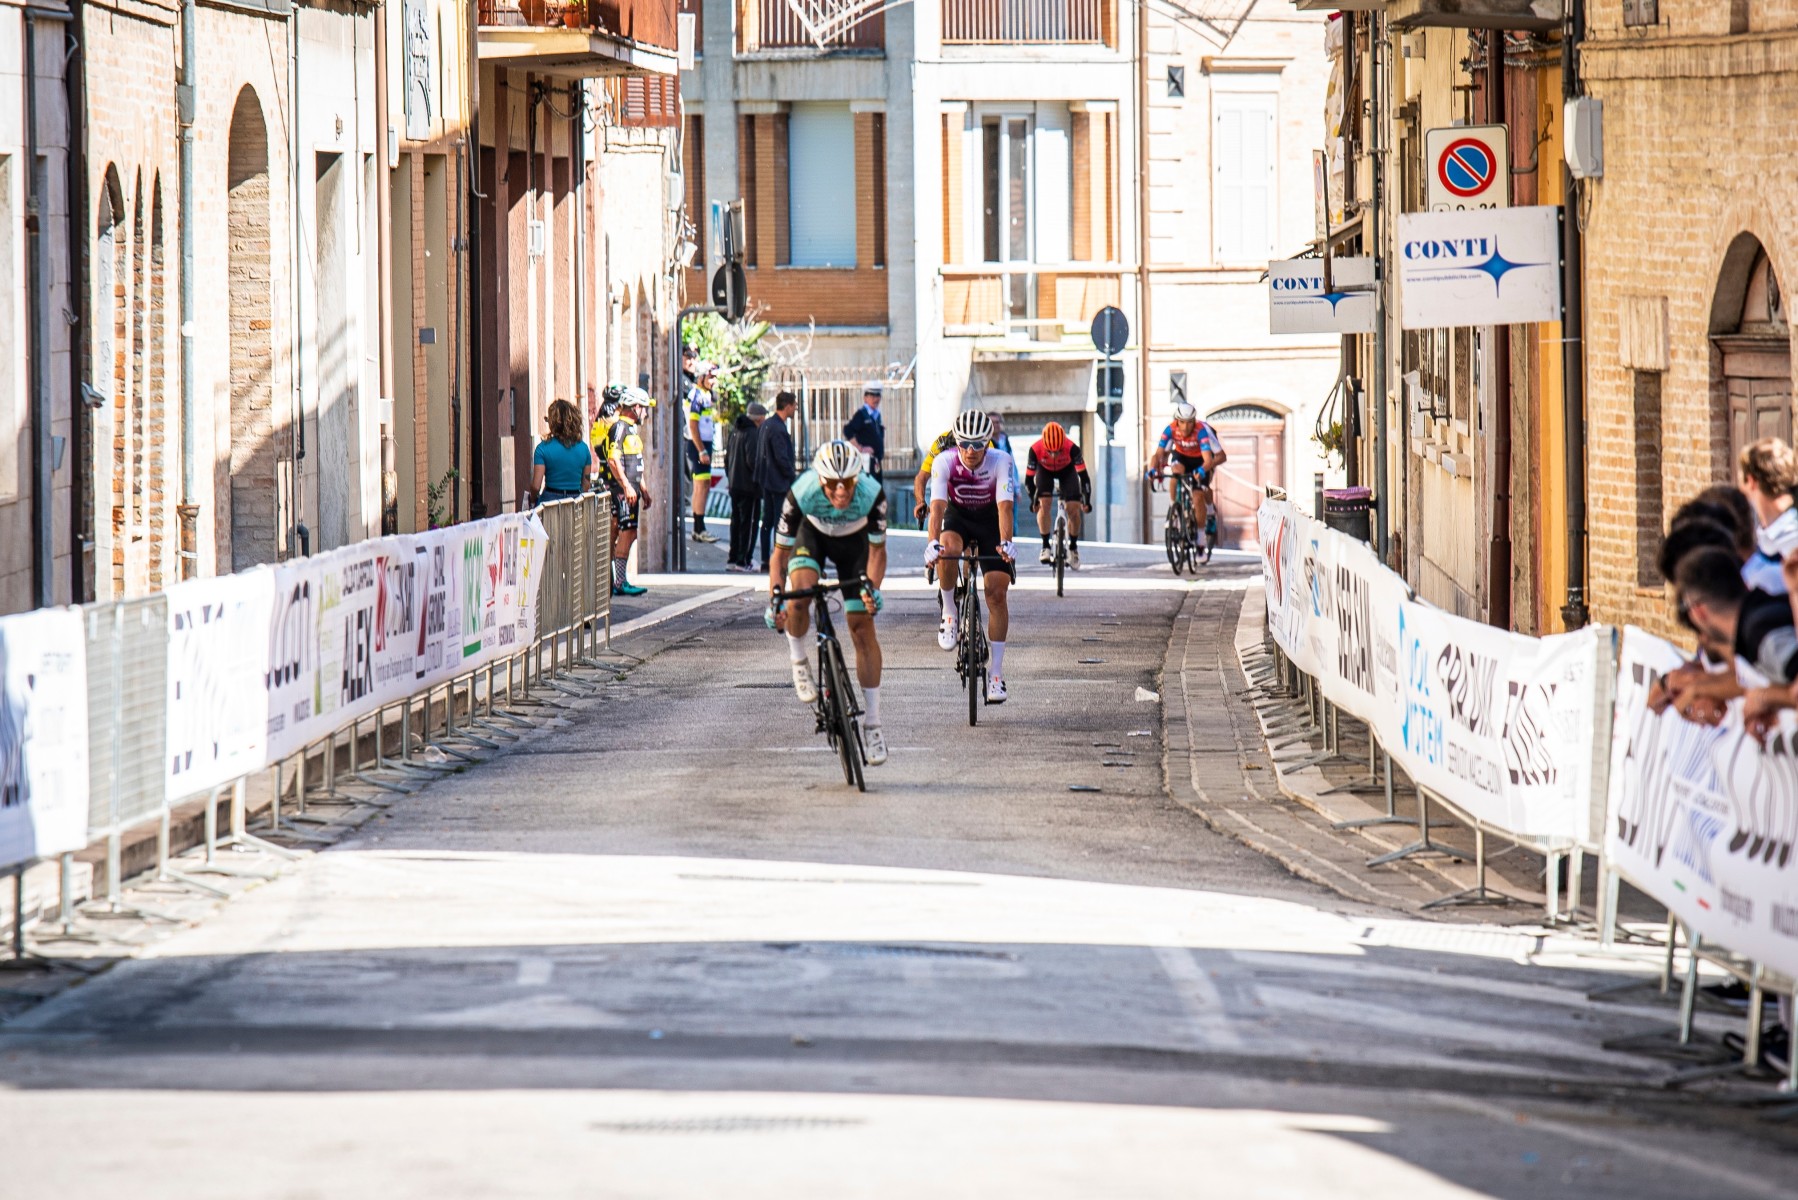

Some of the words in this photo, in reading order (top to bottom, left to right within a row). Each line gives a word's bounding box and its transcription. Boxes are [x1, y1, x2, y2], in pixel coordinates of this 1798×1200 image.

[1404, 238, 1488, 260] CONTI
[341, 605, 373, 708] ALEX
[255, 953, 1027, 989] STOP
